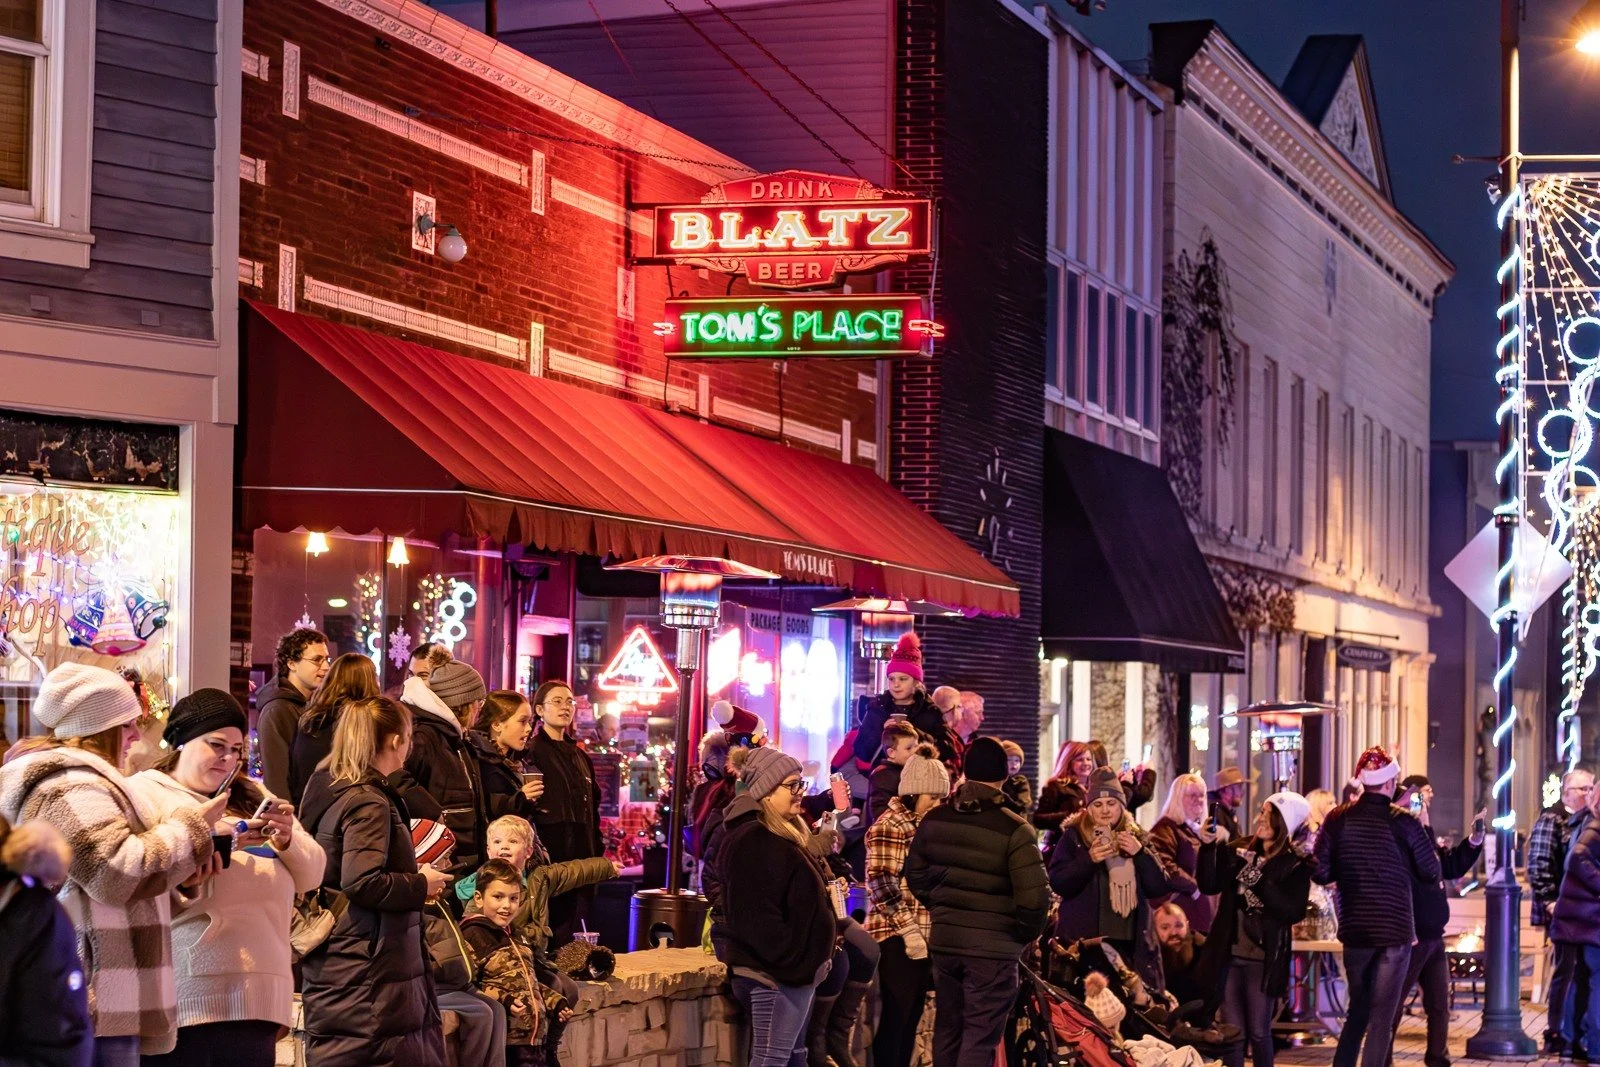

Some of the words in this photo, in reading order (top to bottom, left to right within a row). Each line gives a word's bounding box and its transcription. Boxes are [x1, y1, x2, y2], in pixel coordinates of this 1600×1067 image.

[750, 181, 834, 199] DRINK
[670, 208, 911, 249] BLATZ
[757, 262, 822, 280] BEER
[679, 303, 783, 343] TOM'S
[792, 309, 904, 341] PLACE
[751, 612, 780, 632] PACKAGE
[786, 616, 809, 635] GOODS
